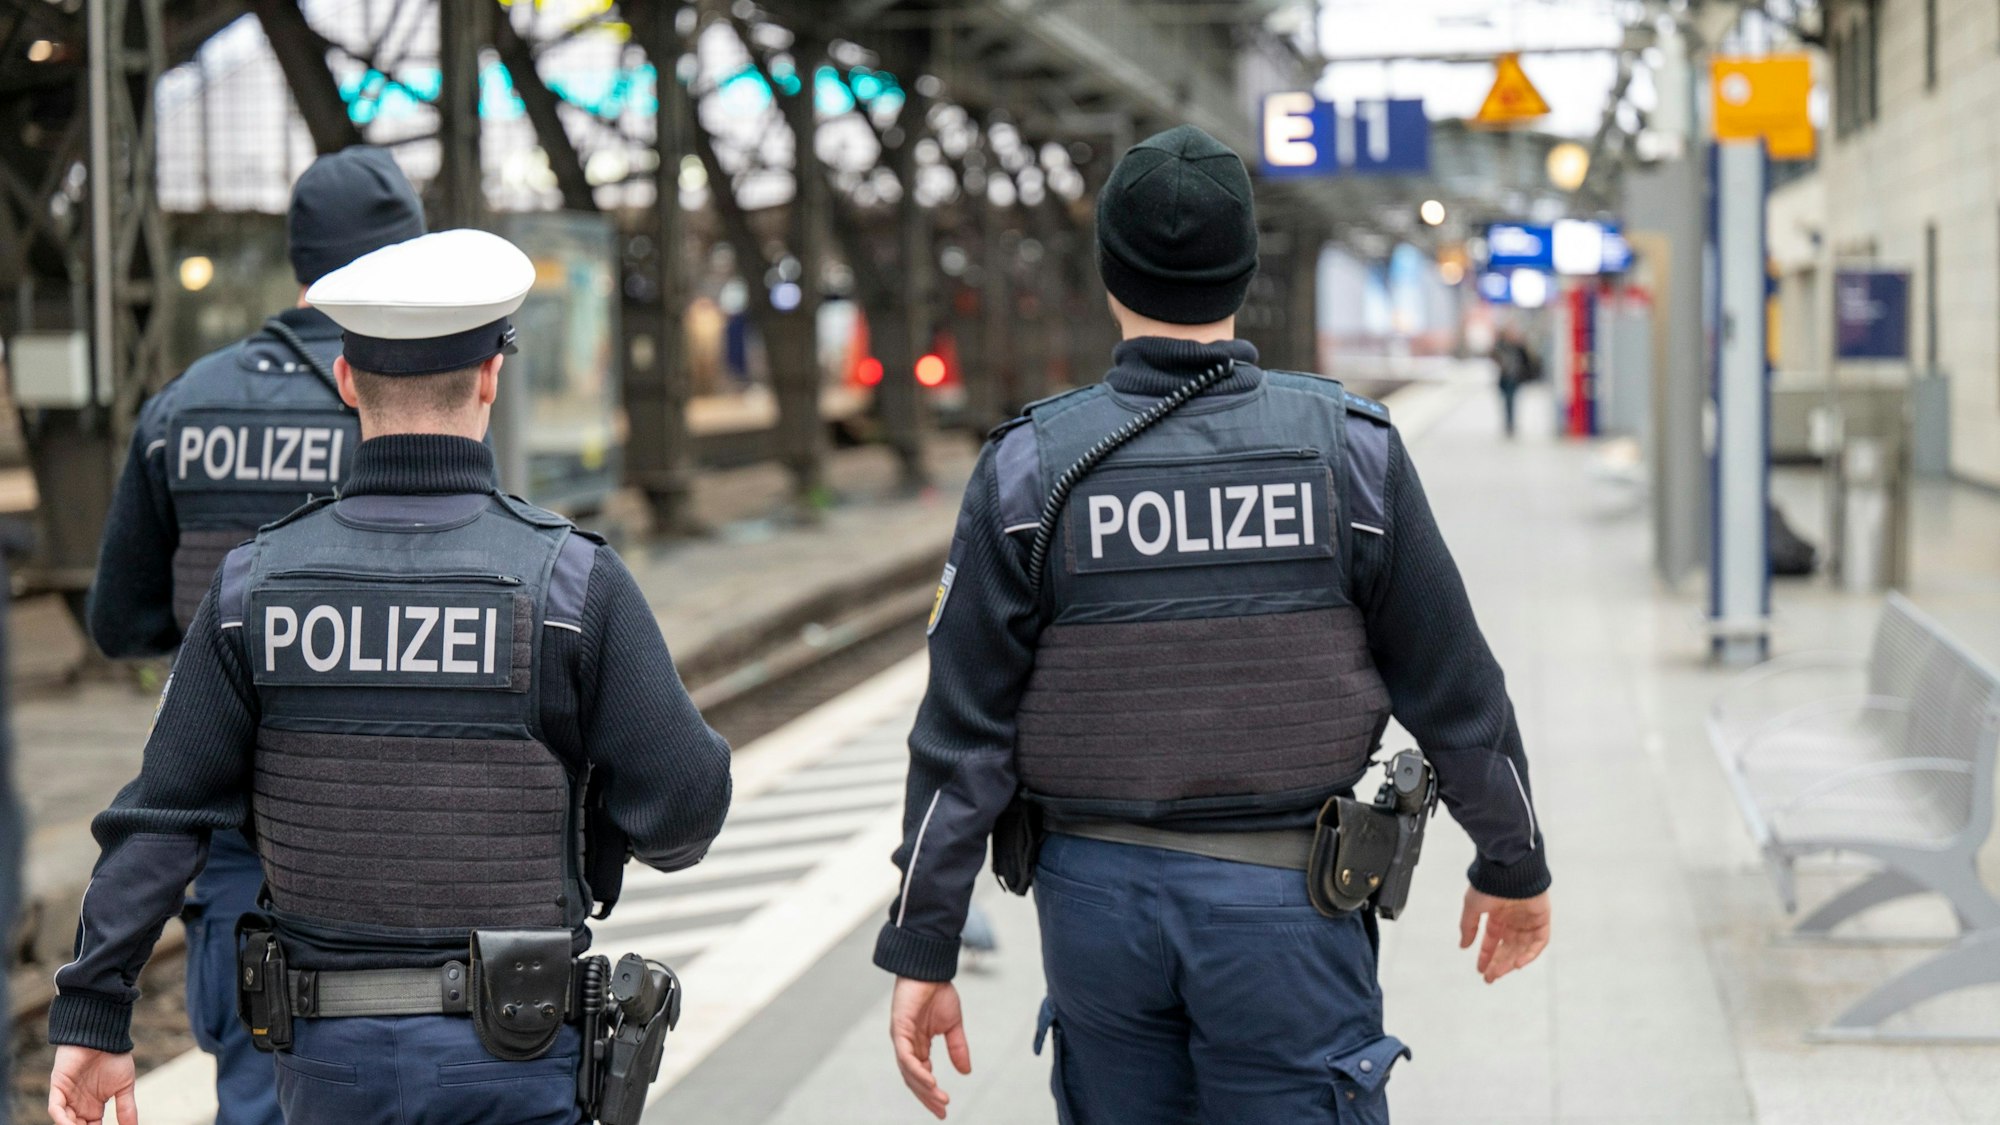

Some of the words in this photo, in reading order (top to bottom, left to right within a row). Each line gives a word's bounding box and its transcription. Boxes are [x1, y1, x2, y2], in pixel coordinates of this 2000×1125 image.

[1264, 91, 1317, 166] E
[178, 426, 344, 482] POLIZEI
[1088, 482, 1315, 559] POLIZEI
[264, 604, 497, 674] POLIZEI
